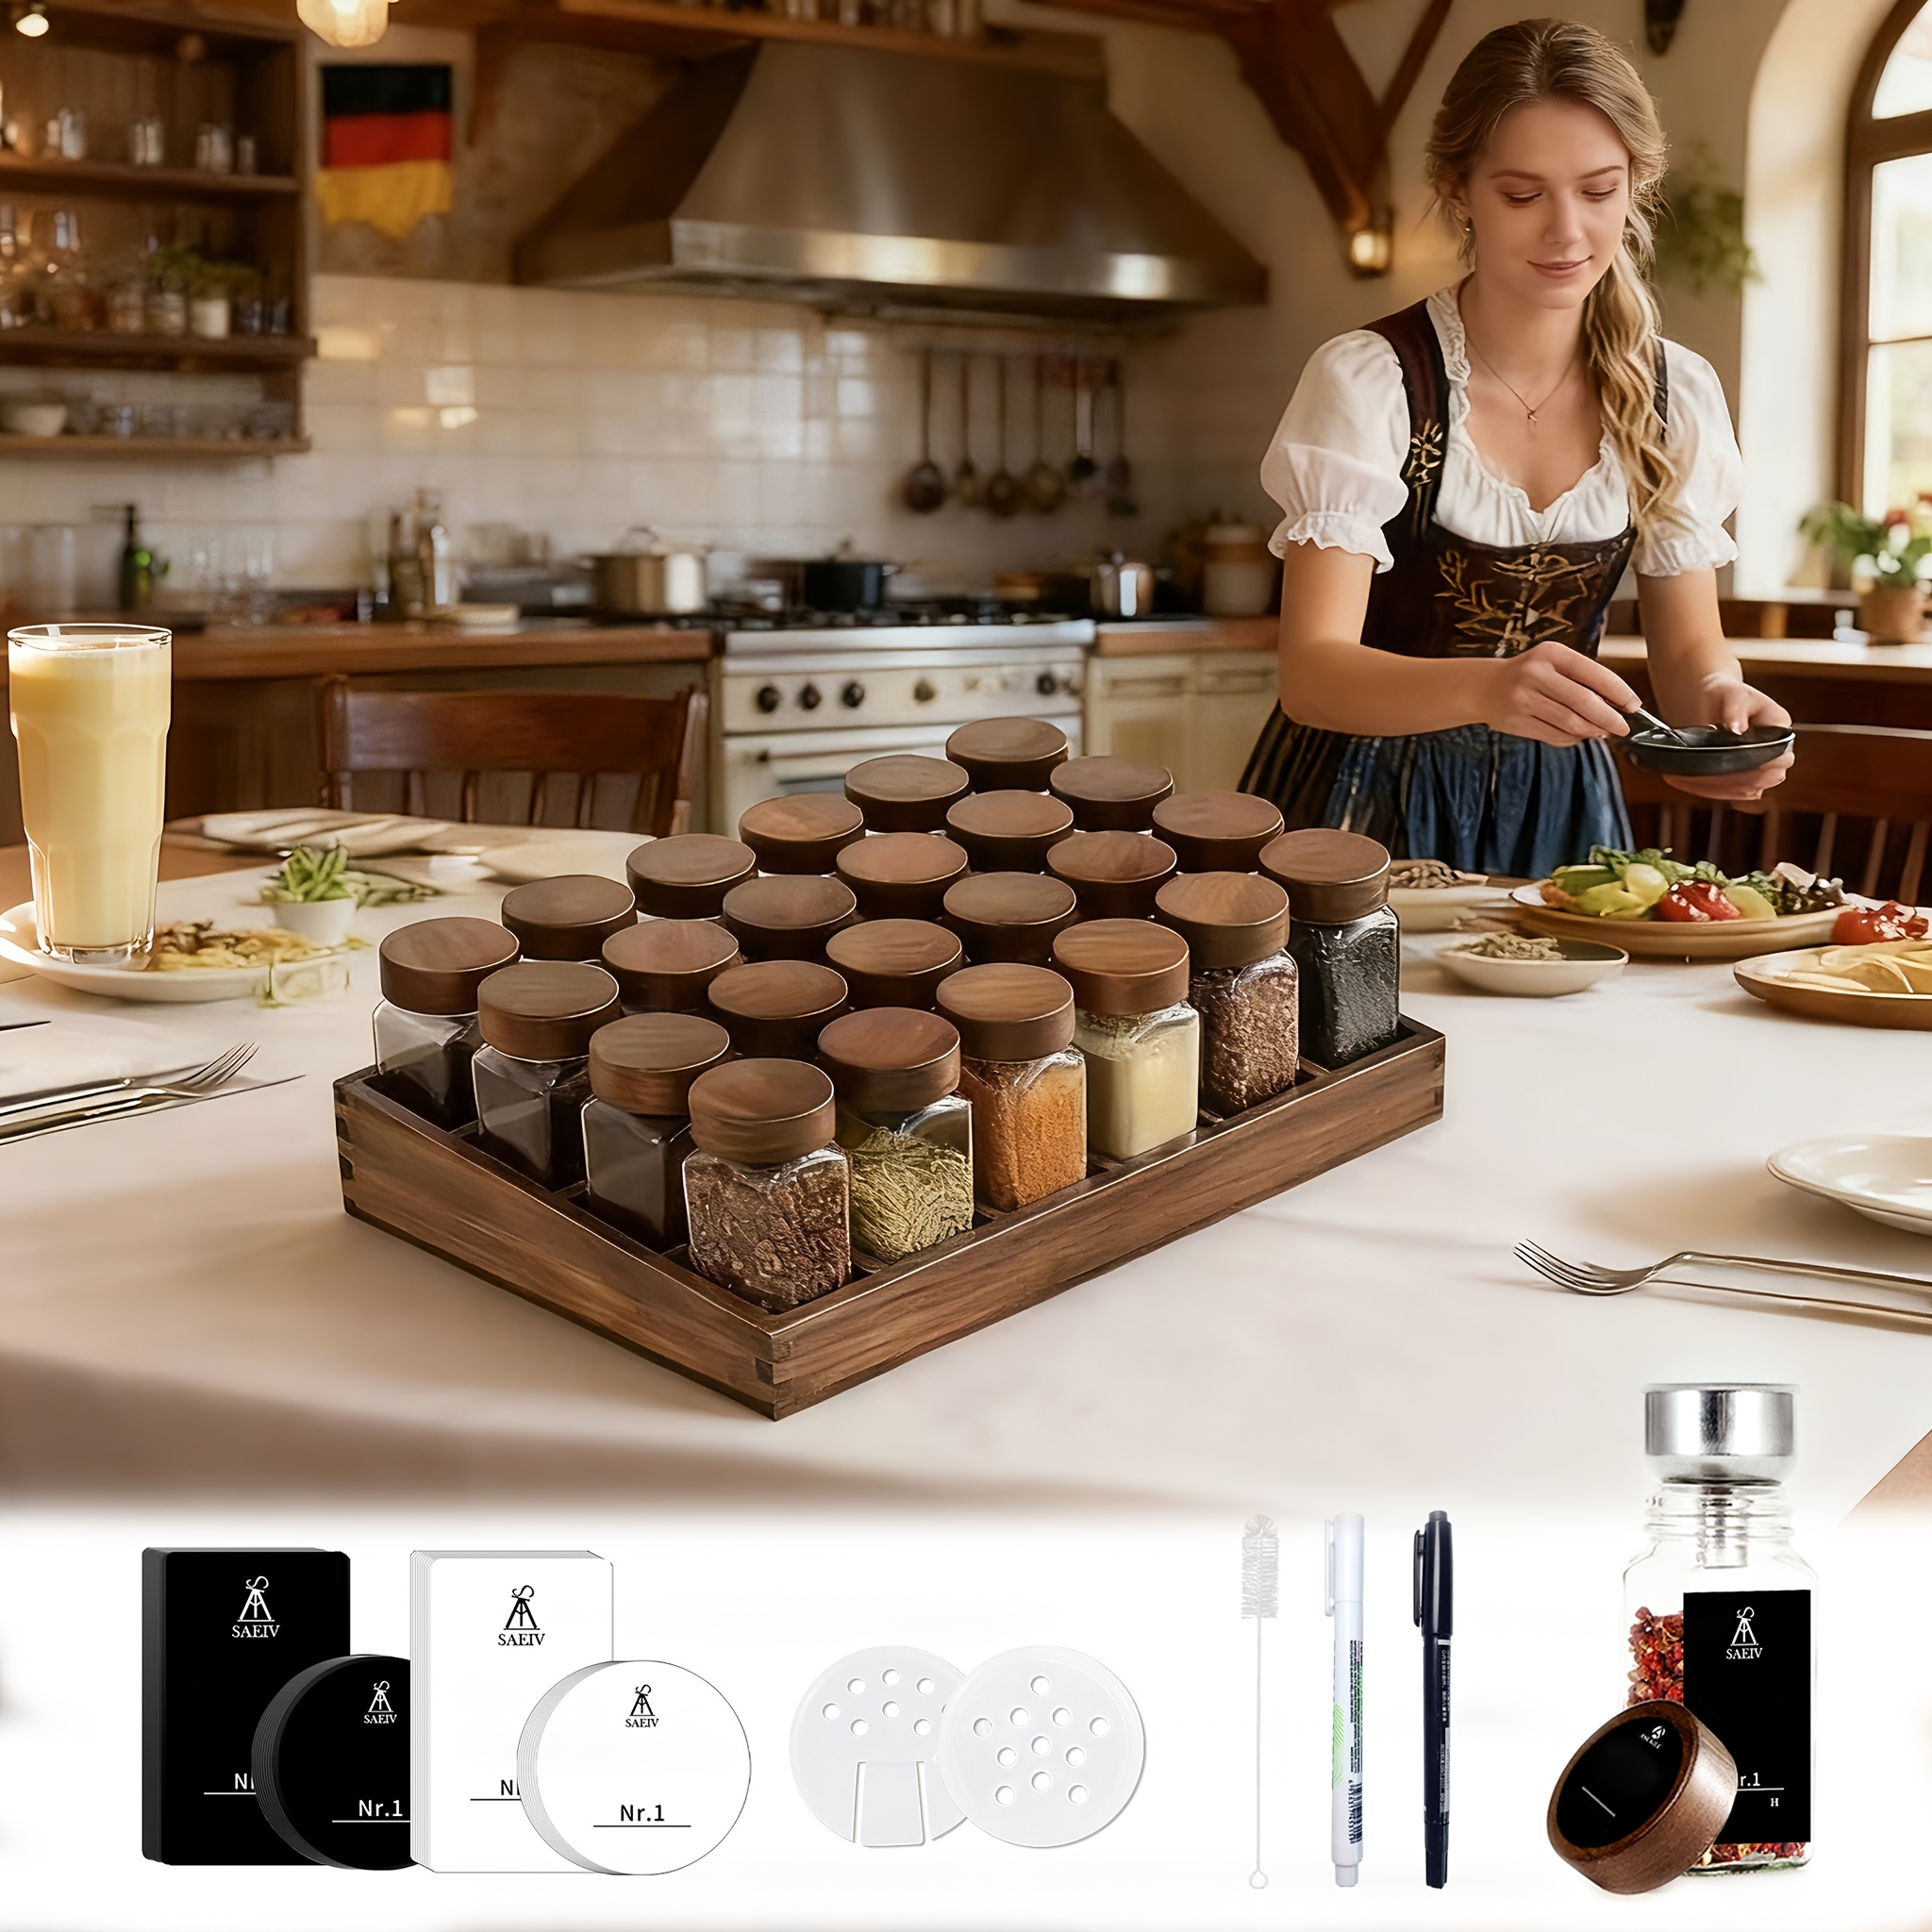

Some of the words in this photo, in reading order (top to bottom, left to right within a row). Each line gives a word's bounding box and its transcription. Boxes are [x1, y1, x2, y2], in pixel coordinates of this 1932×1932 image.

[232, 1624, 281, 1639] SAEIV
[498, 1633, 546, 1646] SAEIV
[1725, 1647, 1763, 1660] SAEIV
[363, 1713, 398, 1724] SAEIV
[625, 1718, 659, 1728] SAEIV
[1740, 1772, 1761, 1787] r.1
[358, 1799, 403, 1818] Nr.1
[1770, 1797, 1780, 1807] H
[620, 1804, 665, 1823] Nr.1
